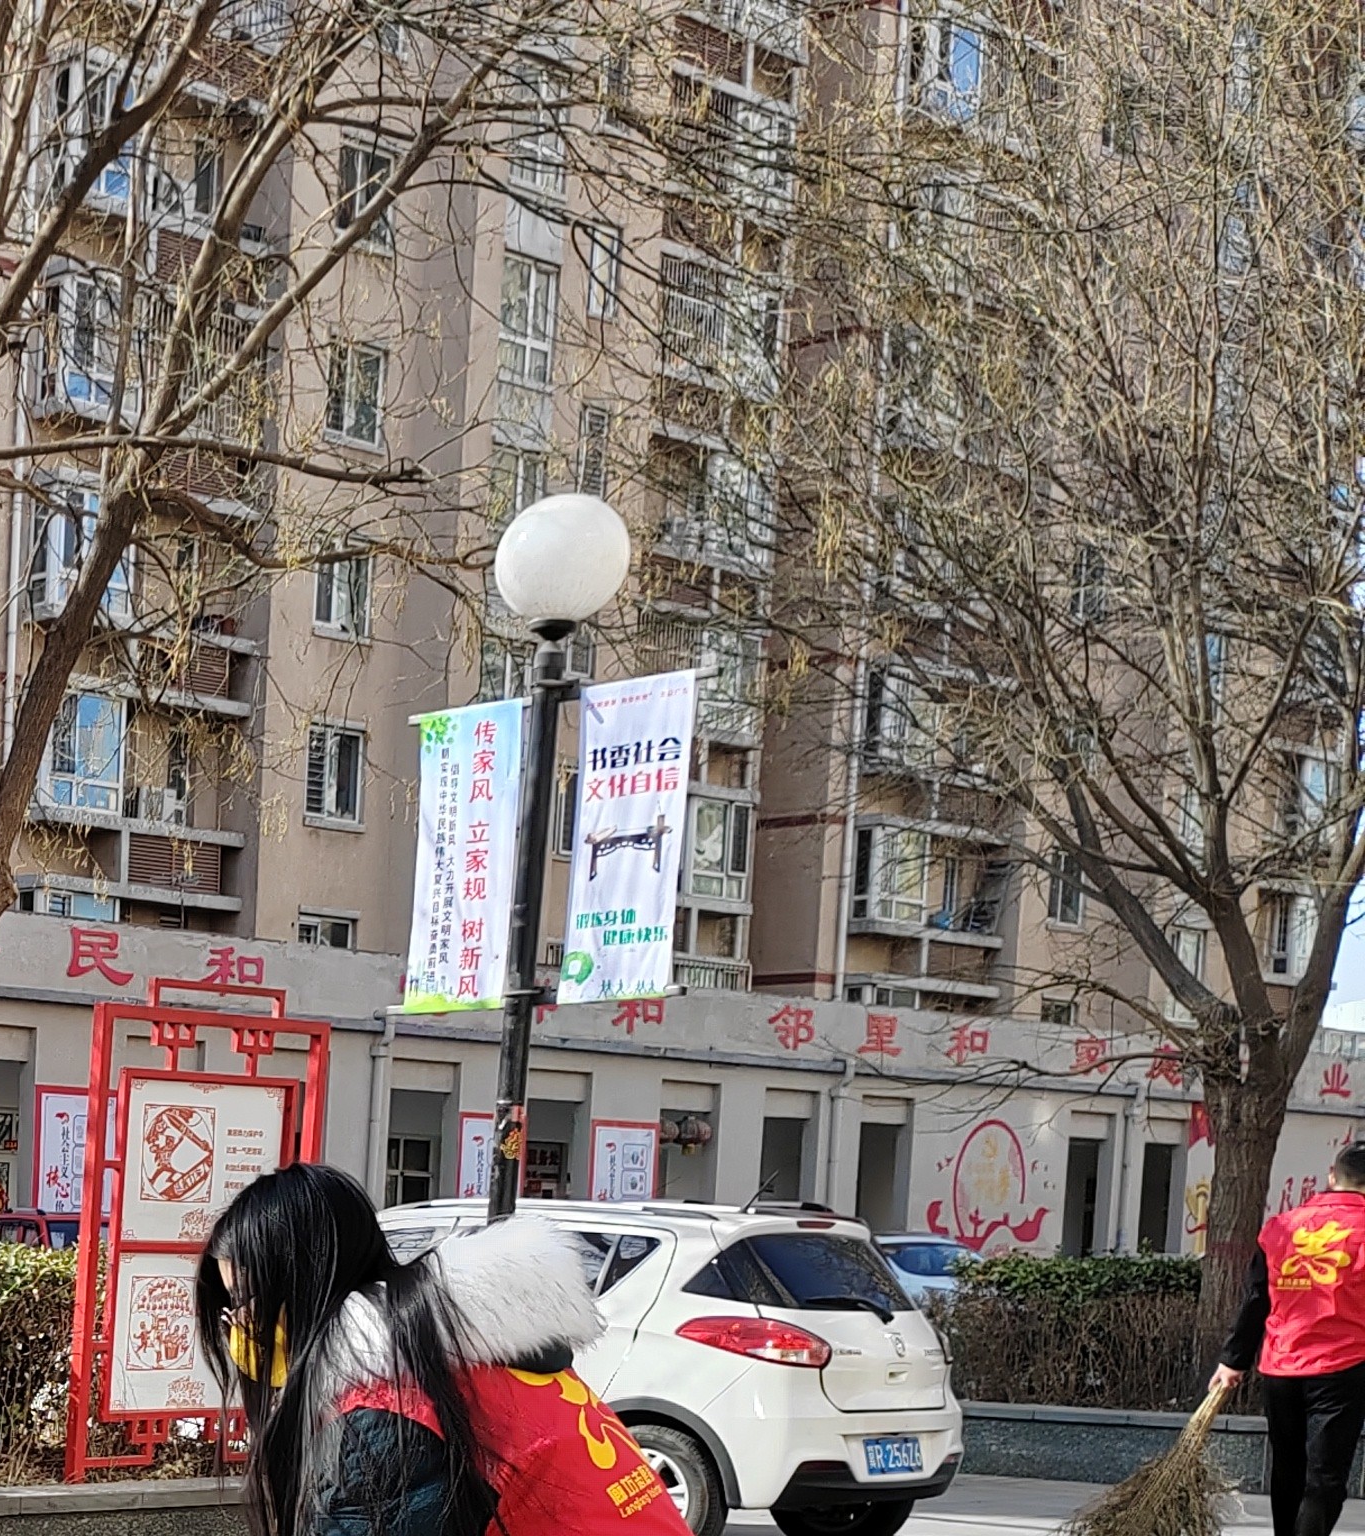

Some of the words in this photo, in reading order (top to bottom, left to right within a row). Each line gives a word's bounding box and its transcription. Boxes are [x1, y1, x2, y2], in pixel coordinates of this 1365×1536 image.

[469, 719, 499, 804] 传家风
[585, 766, 681, 803] 文化自信
[587, 736, 683, 772] 书香社会
[462, 819, 491, 902] 立家规
[456, 917, 486, 999] 树新风
[603, 925, 669, 947] 健康快乐
[768, 1004, 991, 1066] 邻里和
